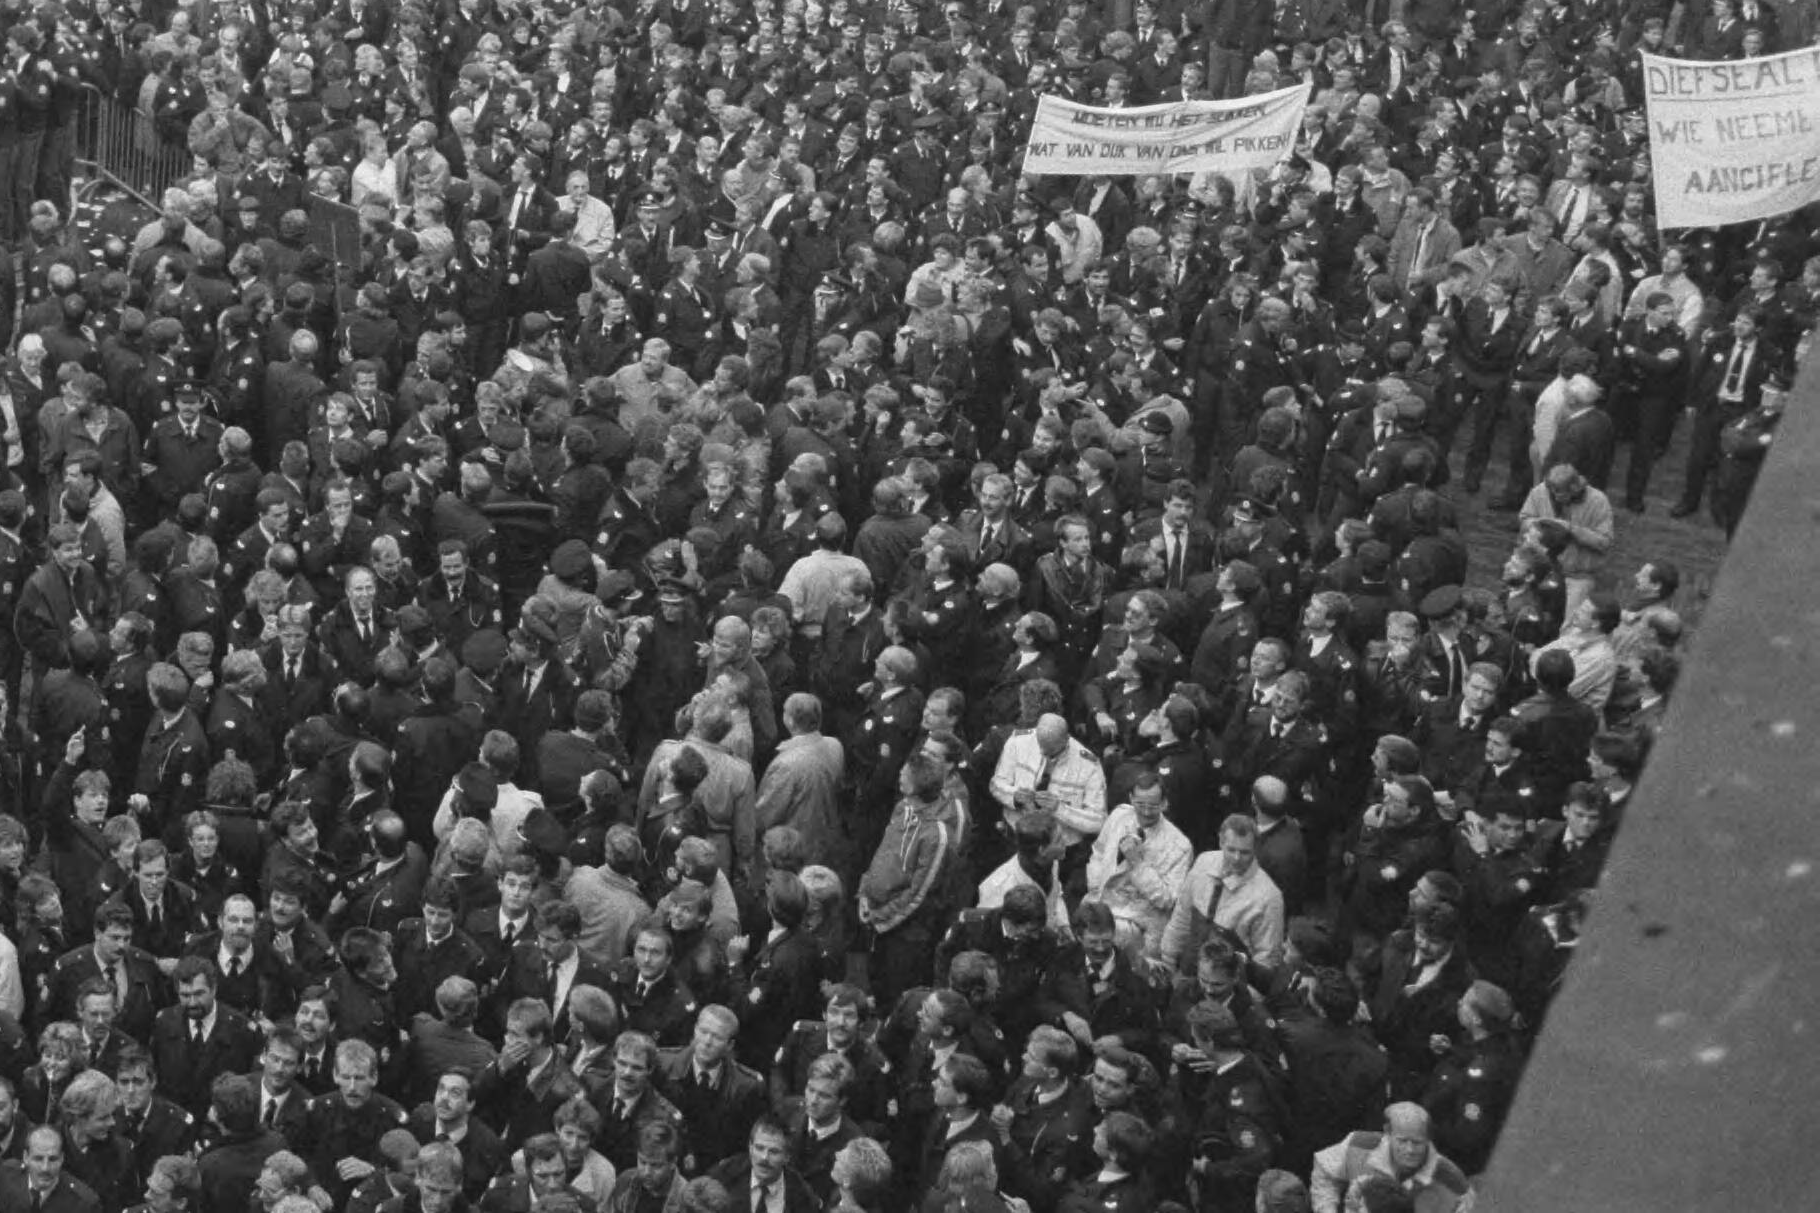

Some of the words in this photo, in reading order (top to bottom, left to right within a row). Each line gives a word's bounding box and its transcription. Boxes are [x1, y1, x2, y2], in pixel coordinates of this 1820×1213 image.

[1070, 110, 1137, 128] MOETEN
[1169, 110, 1204, 128] HET
[1657, 120, 1703, 144] WIE
[1029, 142, 1059, 157] WAT
[1066, 142, 1094, 158] VAN
[1099, 142, 1126, 158] DIJK
[1136, 143, 1164, 158] VAN
[1170, 143, 1199, 159] ONS
